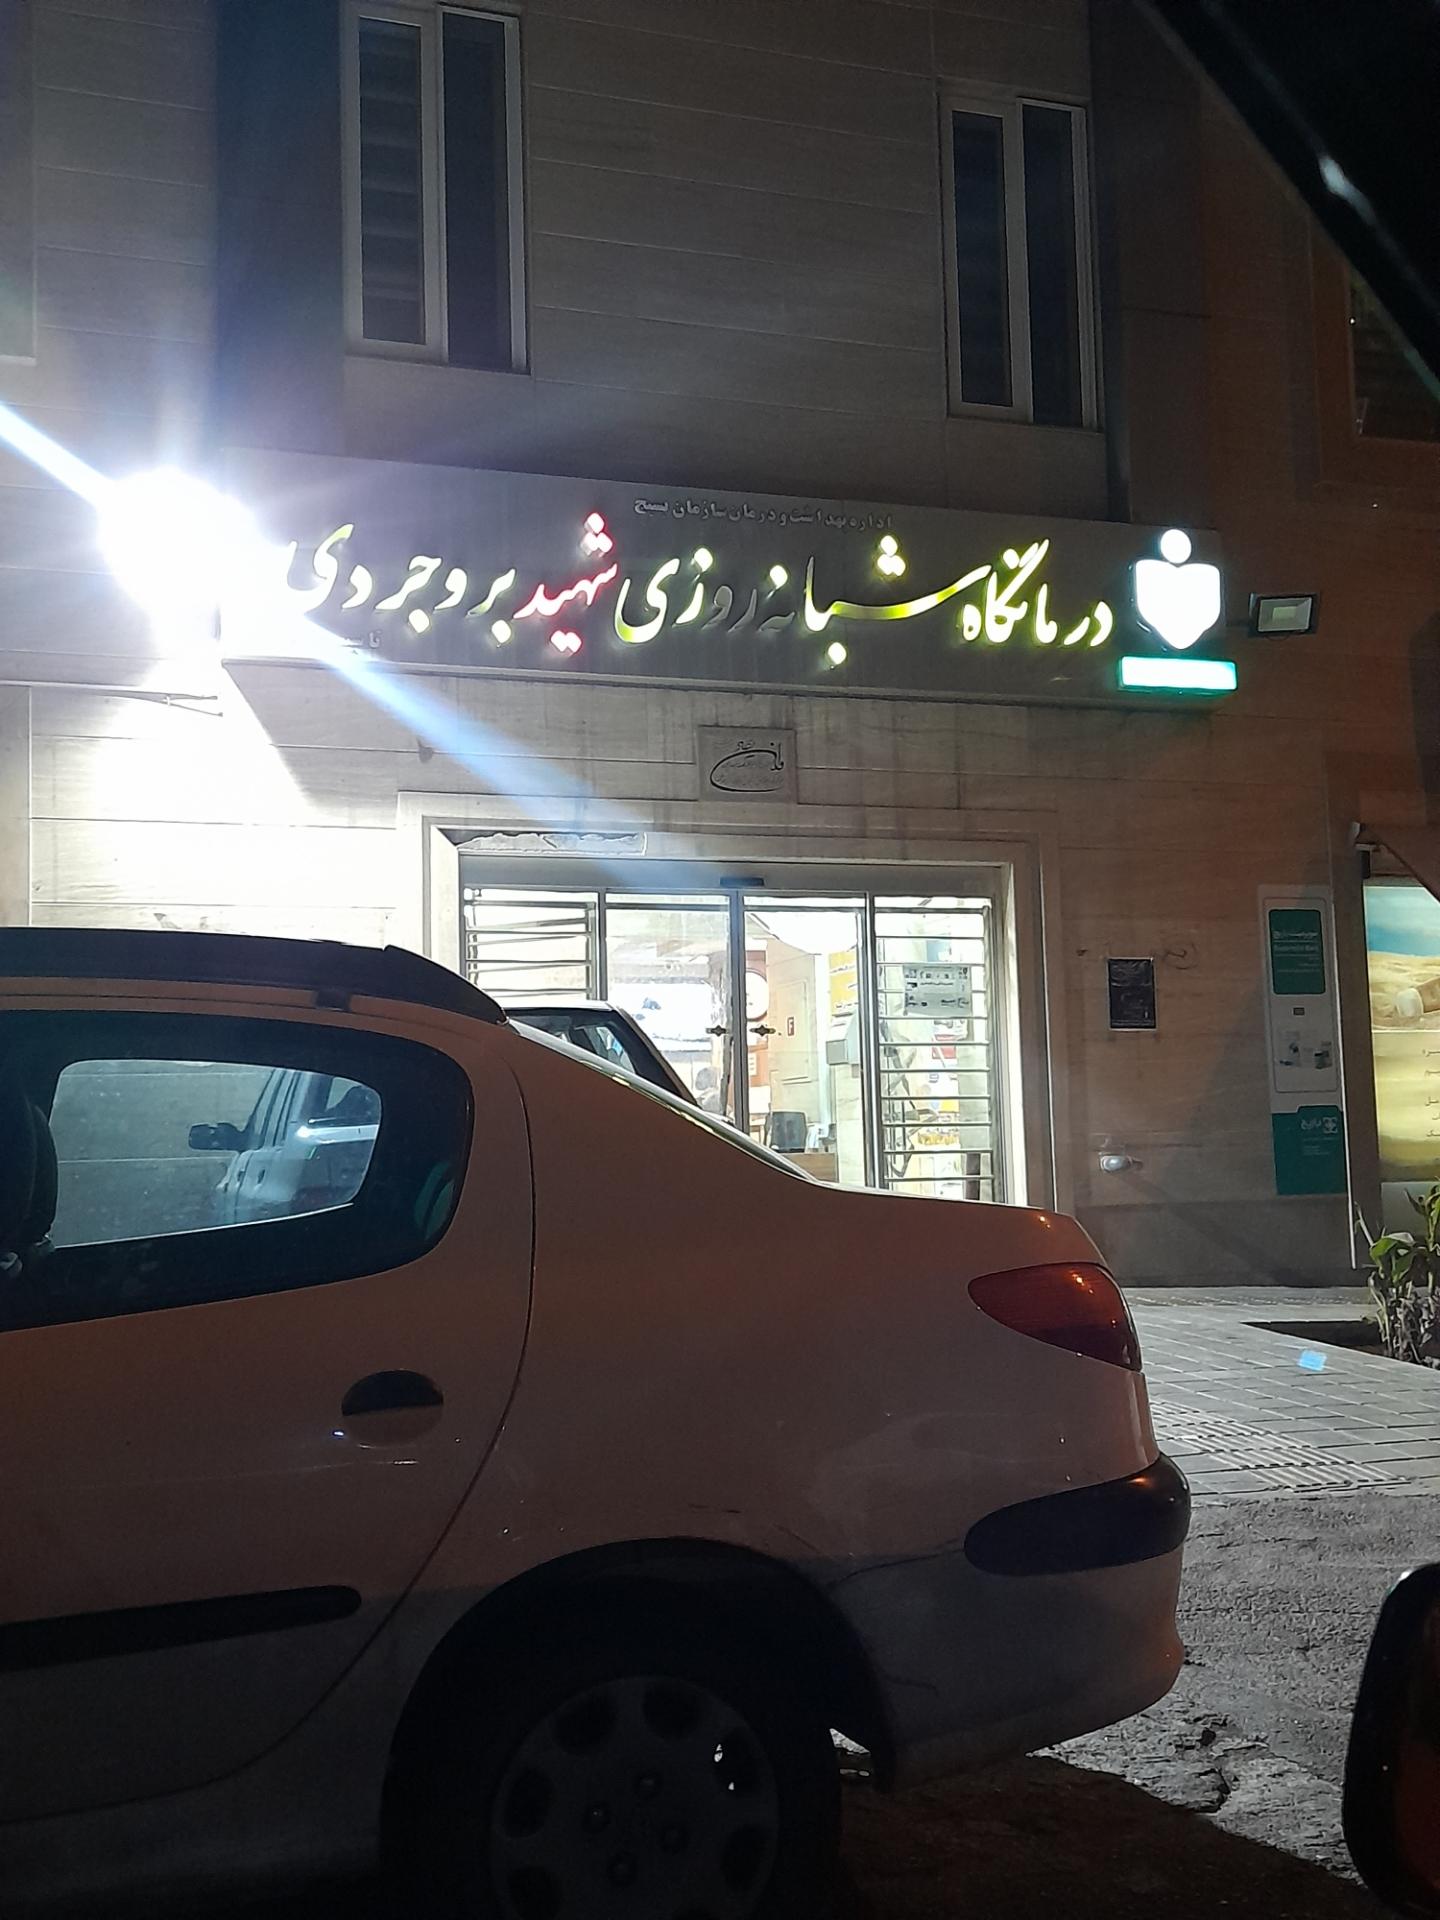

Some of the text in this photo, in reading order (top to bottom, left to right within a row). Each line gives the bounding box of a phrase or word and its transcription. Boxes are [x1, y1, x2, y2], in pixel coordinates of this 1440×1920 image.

[286, 523, 516, 647] بروجردی
[512, 512, 618, 653] شهید
[959, 538, 1113, 647] درمانگاه
